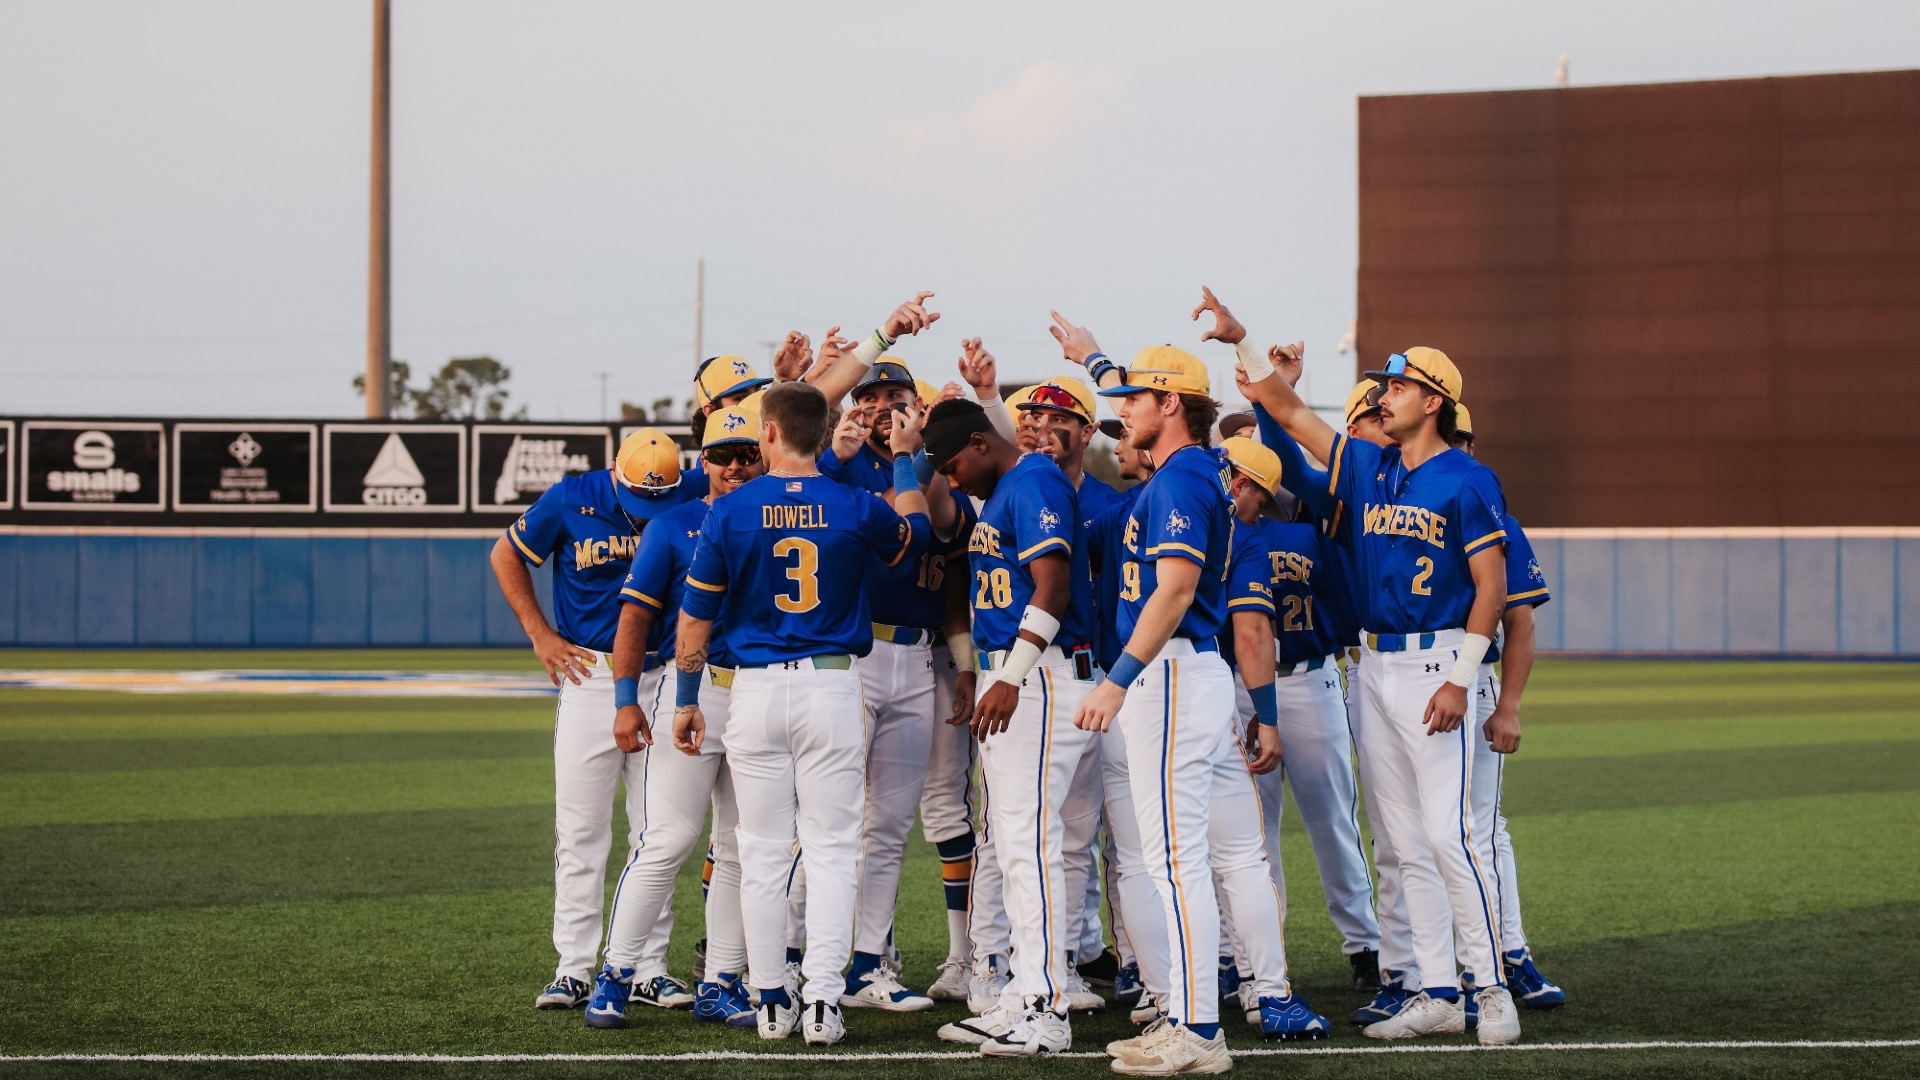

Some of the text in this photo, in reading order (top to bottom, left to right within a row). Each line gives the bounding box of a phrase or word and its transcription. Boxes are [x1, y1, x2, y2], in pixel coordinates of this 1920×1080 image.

[47, 469, 141, 492] smalls
[362, 487, 427, 505] CITGO
[762, 505, 828, 529] DOWELL
[773, 536, 821, 614] 3
[917, 552, 945, 592] 16
[1120, 561, 1141, 603] 9
[1268, 551, 1314, 586] ESE
[1411, 555, 1434, 597] 2
[975, 567, 1013, 610] 28
[1282, 594, 1314, 632] 21
